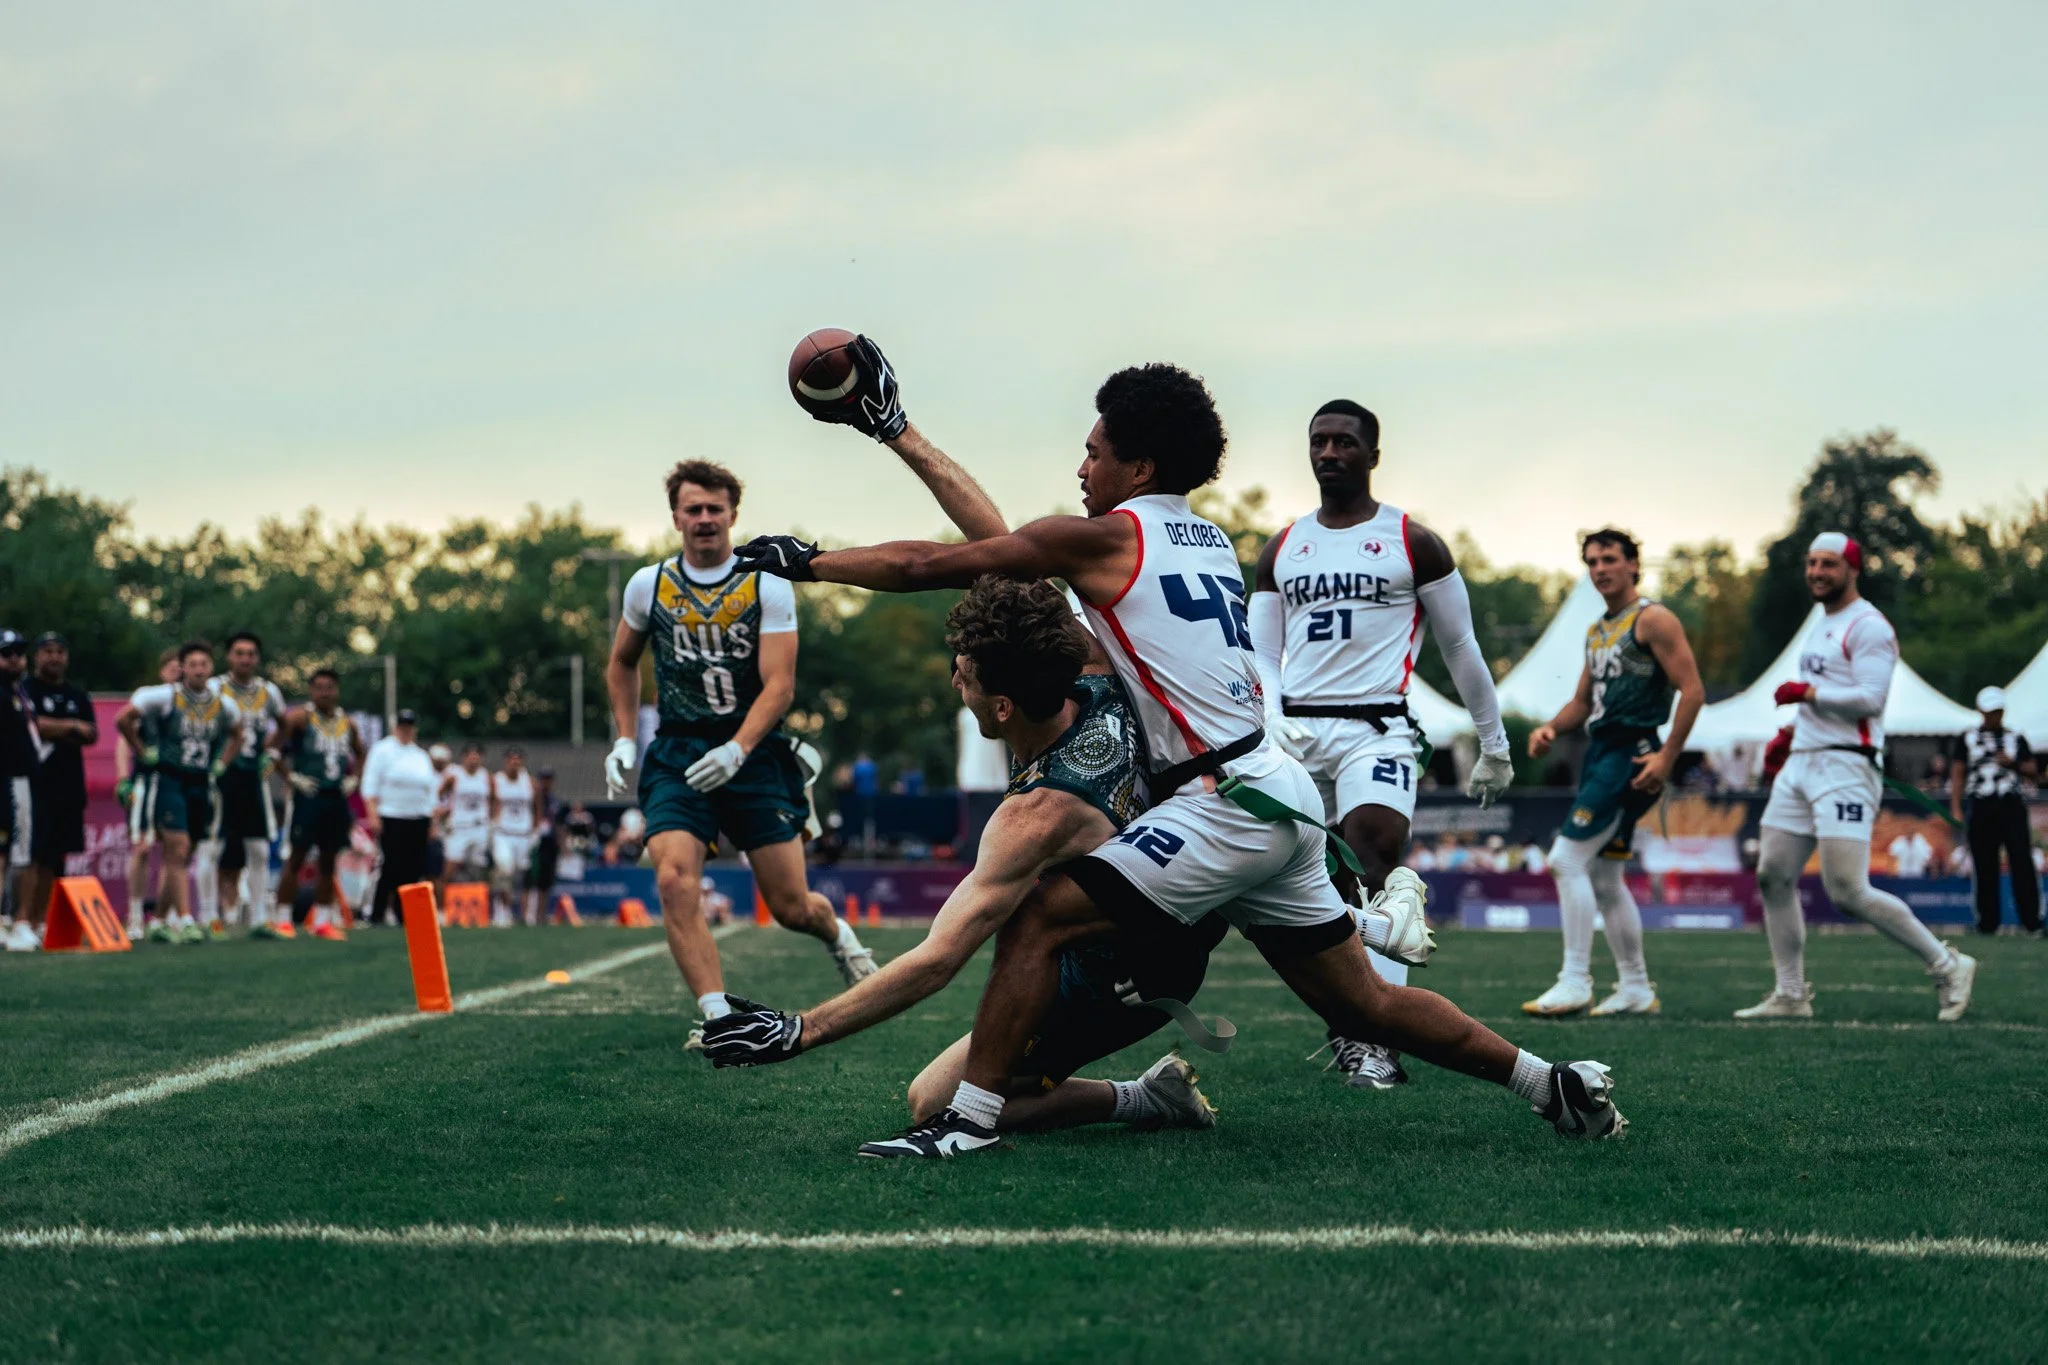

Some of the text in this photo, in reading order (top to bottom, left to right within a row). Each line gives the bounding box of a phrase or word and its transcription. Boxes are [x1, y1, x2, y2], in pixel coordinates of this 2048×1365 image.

[1283, 572, 1390, 608] FRANCE
[1158, 573, 1255, 652] 42
[1307, 609, 1353, 643] 21
[672, 622, 753, 664] AUS
[701, 666, 738, 716] 0
[1372, 757, 1411, 792] 21
[1834, 803, 1864, 822] 19
[1117, 825, 1186, 869] 42
